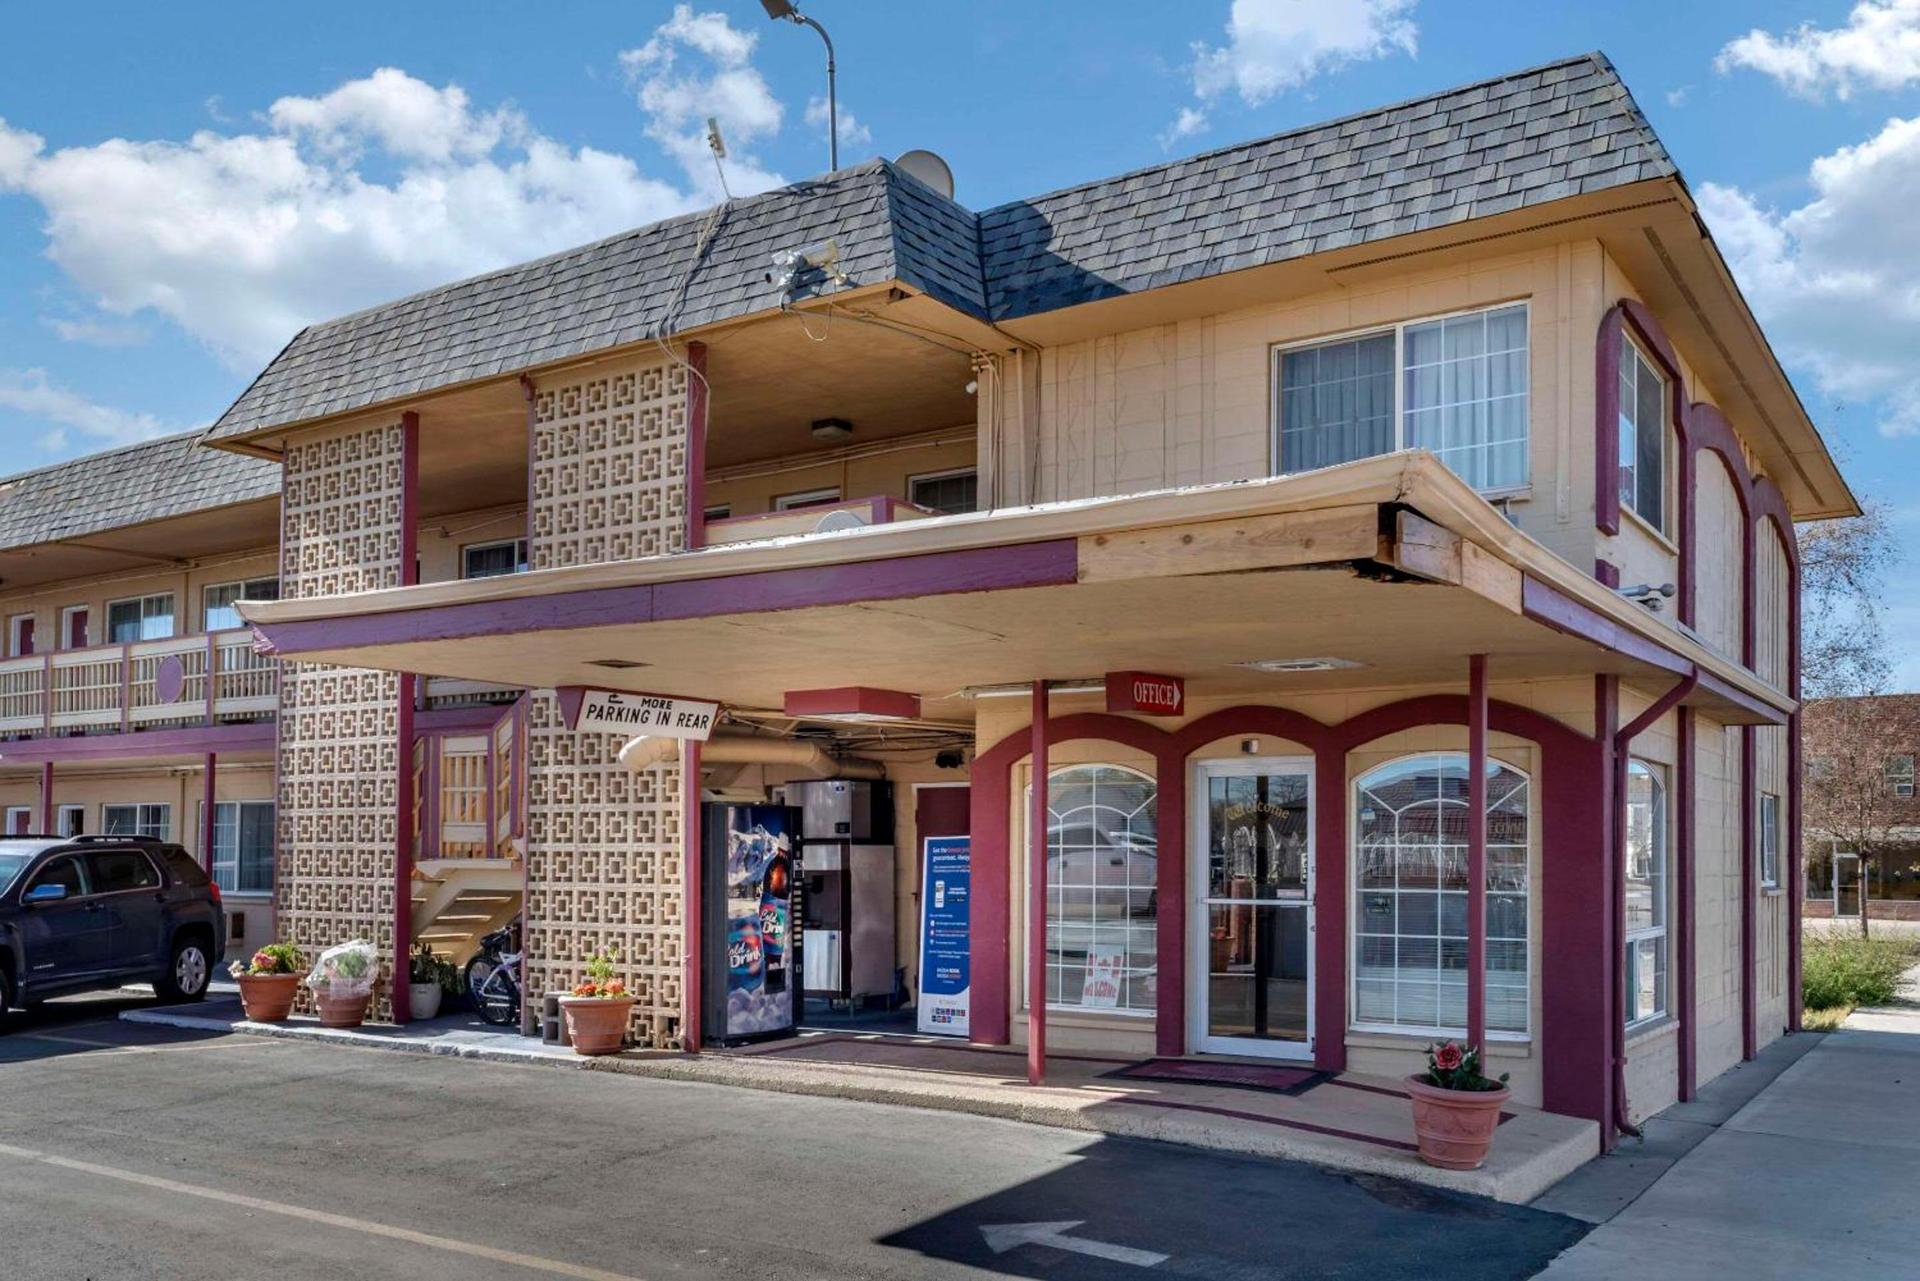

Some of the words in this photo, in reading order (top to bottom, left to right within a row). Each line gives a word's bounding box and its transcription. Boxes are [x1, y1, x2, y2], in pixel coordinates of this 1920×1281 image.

[1133, 681, 1173, 705] OFFICE
[641, 698, 673, 710] MORE
[586, 704, 651, 725] PARKING
[655, 710, 672, 726] IN
[676, 712, 710, 729] REAR
[728, 942, 746, 956] old
